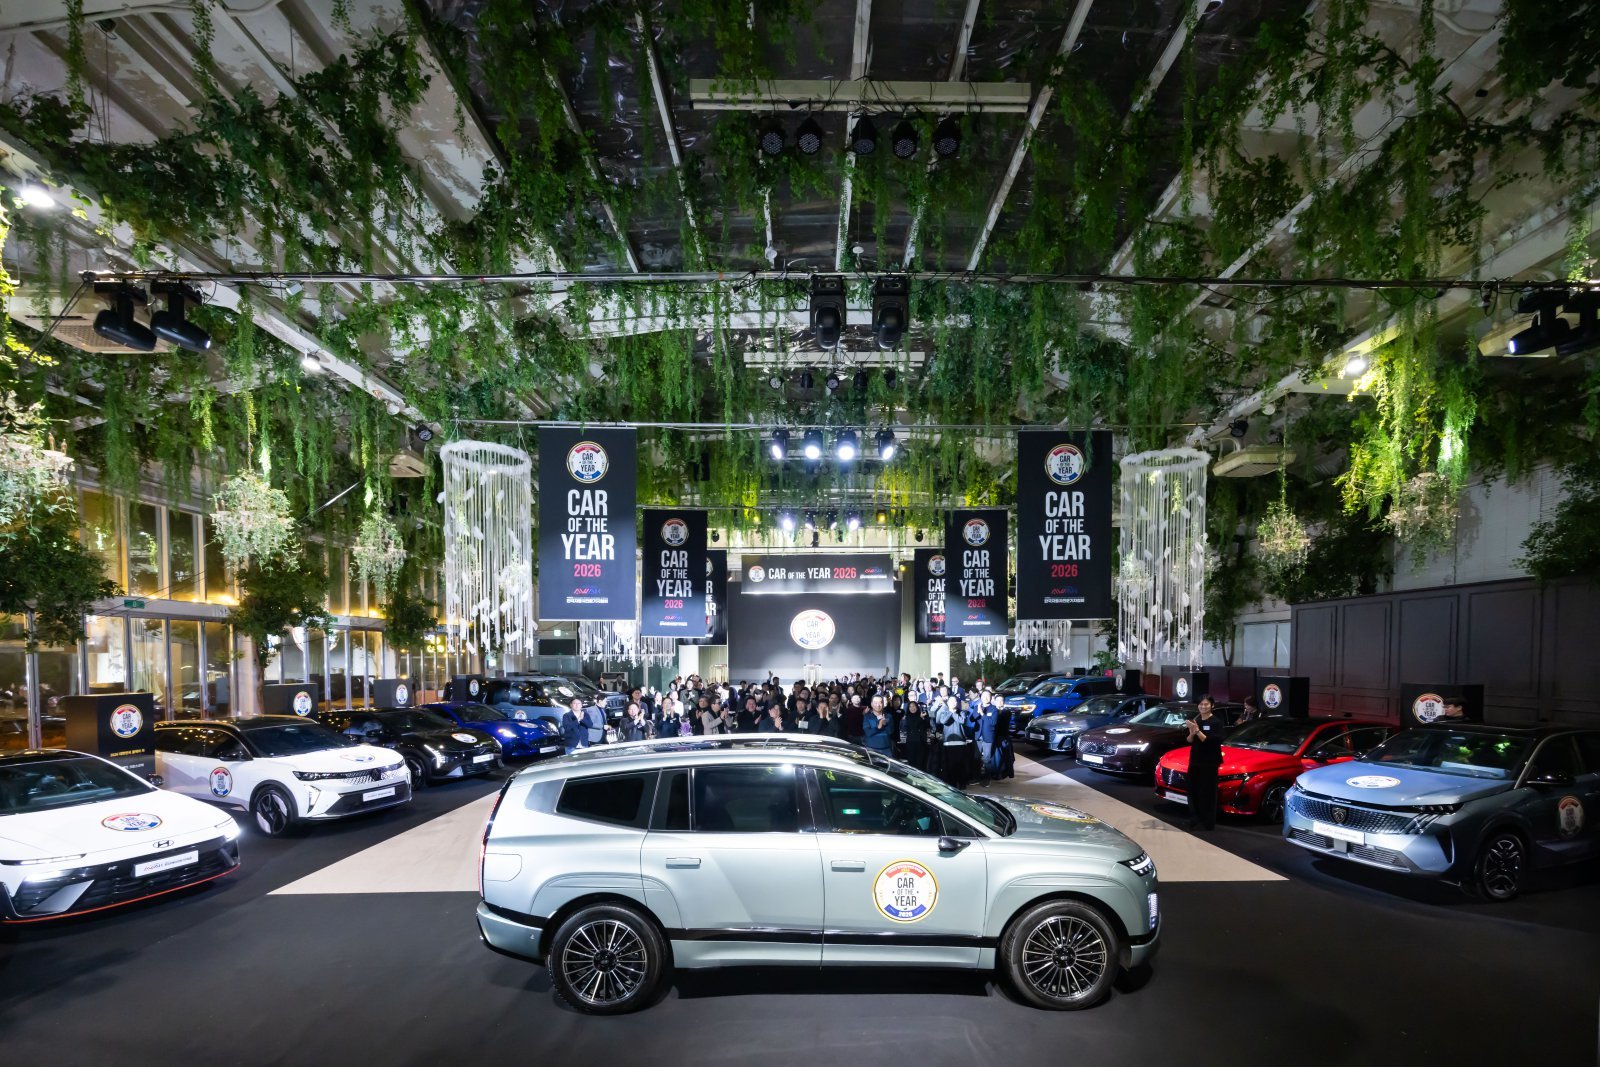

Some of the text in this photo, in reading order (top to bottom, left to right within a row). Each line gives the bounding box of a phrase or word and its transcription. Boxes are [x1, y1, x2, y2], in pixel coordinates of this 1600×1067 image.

[567, 489, 608, 516] CAR
[1045, 491, 1085, 517] CAR
[567, 517, 608, 532] OF THE
[1045, 519, 1085, 533] OF THE
[561, 533, 615, 560] YEAR
[1038, 534, 1091, 560] YEAR
[661, 550, 688, 568] CAR
[963, 550, 990, 568] CAR
[573, 563, 602, 577] 2026
[661, 568, 688, 579] OF THE
[768, 567, 786, 580] CAR
[787, 571, 795, 580] OF
[795, 571, 806, 580] THE
[807, 567, 831, 579] YEAR
[833, 567, 857, 579] 2026
[963, 568, 990, 578] OF THE
[1051, 564, 1078, 577] 2026
[656, 579, 692, 597] YEAR
[959, 579, 995, 597] YEAR
[928, 592, 945, 600] OF TH
[664, 599, 683, 609] 2026
[925, 600, 945, 614] YEA
[967, 599, 986, 608] 2026
[807, 620, 819, 628] CAR
[805, 631, 821, 639] YEAR
[897, 877, 915, 889] CAR
[896, 888, 914, 896] OF THE
[894, 895, 917, 907] YEAR
